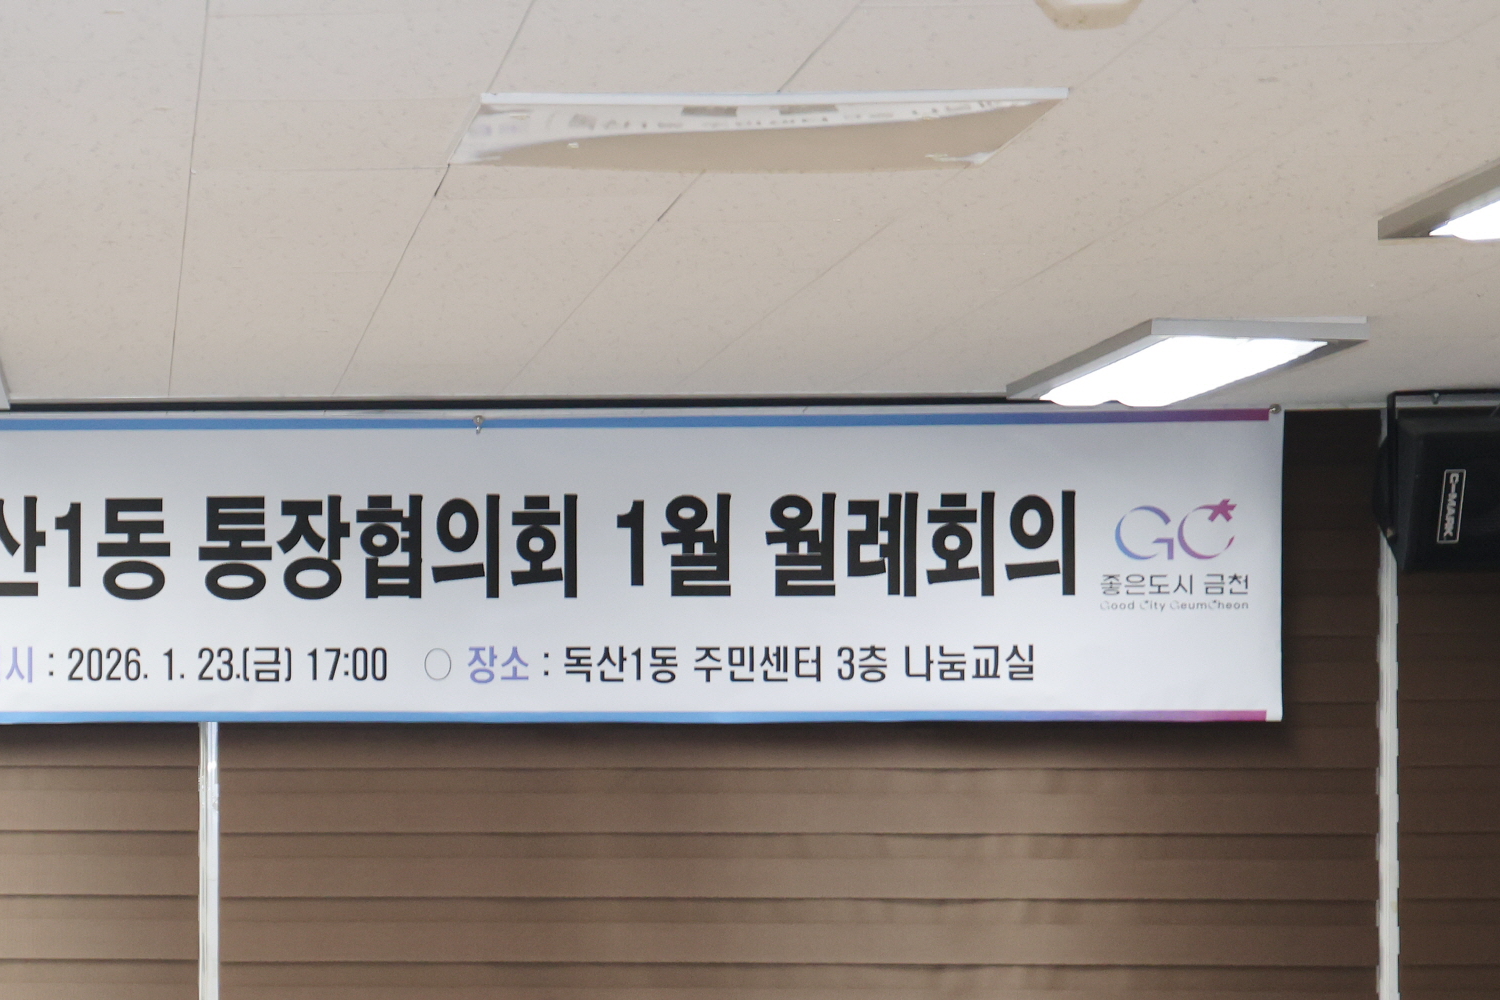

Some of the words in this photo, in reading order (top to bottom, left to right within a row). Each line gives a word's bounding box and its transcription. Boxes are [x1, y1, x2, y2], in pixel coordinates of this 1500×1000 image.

[198, 494, 578, 600] 통장협의회
[617, 492, 732, 597] 1월
[765, 491, 1076, 597] 월례회의
[1100, 573, 1193, 596] 좋은도시
[1204, 573, 1249, 595] 금천
[67, 647, 148, 682] 2026.
[162, 647, 185, 681] 1.
[306, 646, 388, 682] 17:00
[467, 645, 530, 684] 장소
[563, 644, 679, 684] 독산1동
[693, 645, 822, 684] 주민센터
[836, 645, 888, 684] 3층
[904, 644, 1035, 683] 나눔교실
